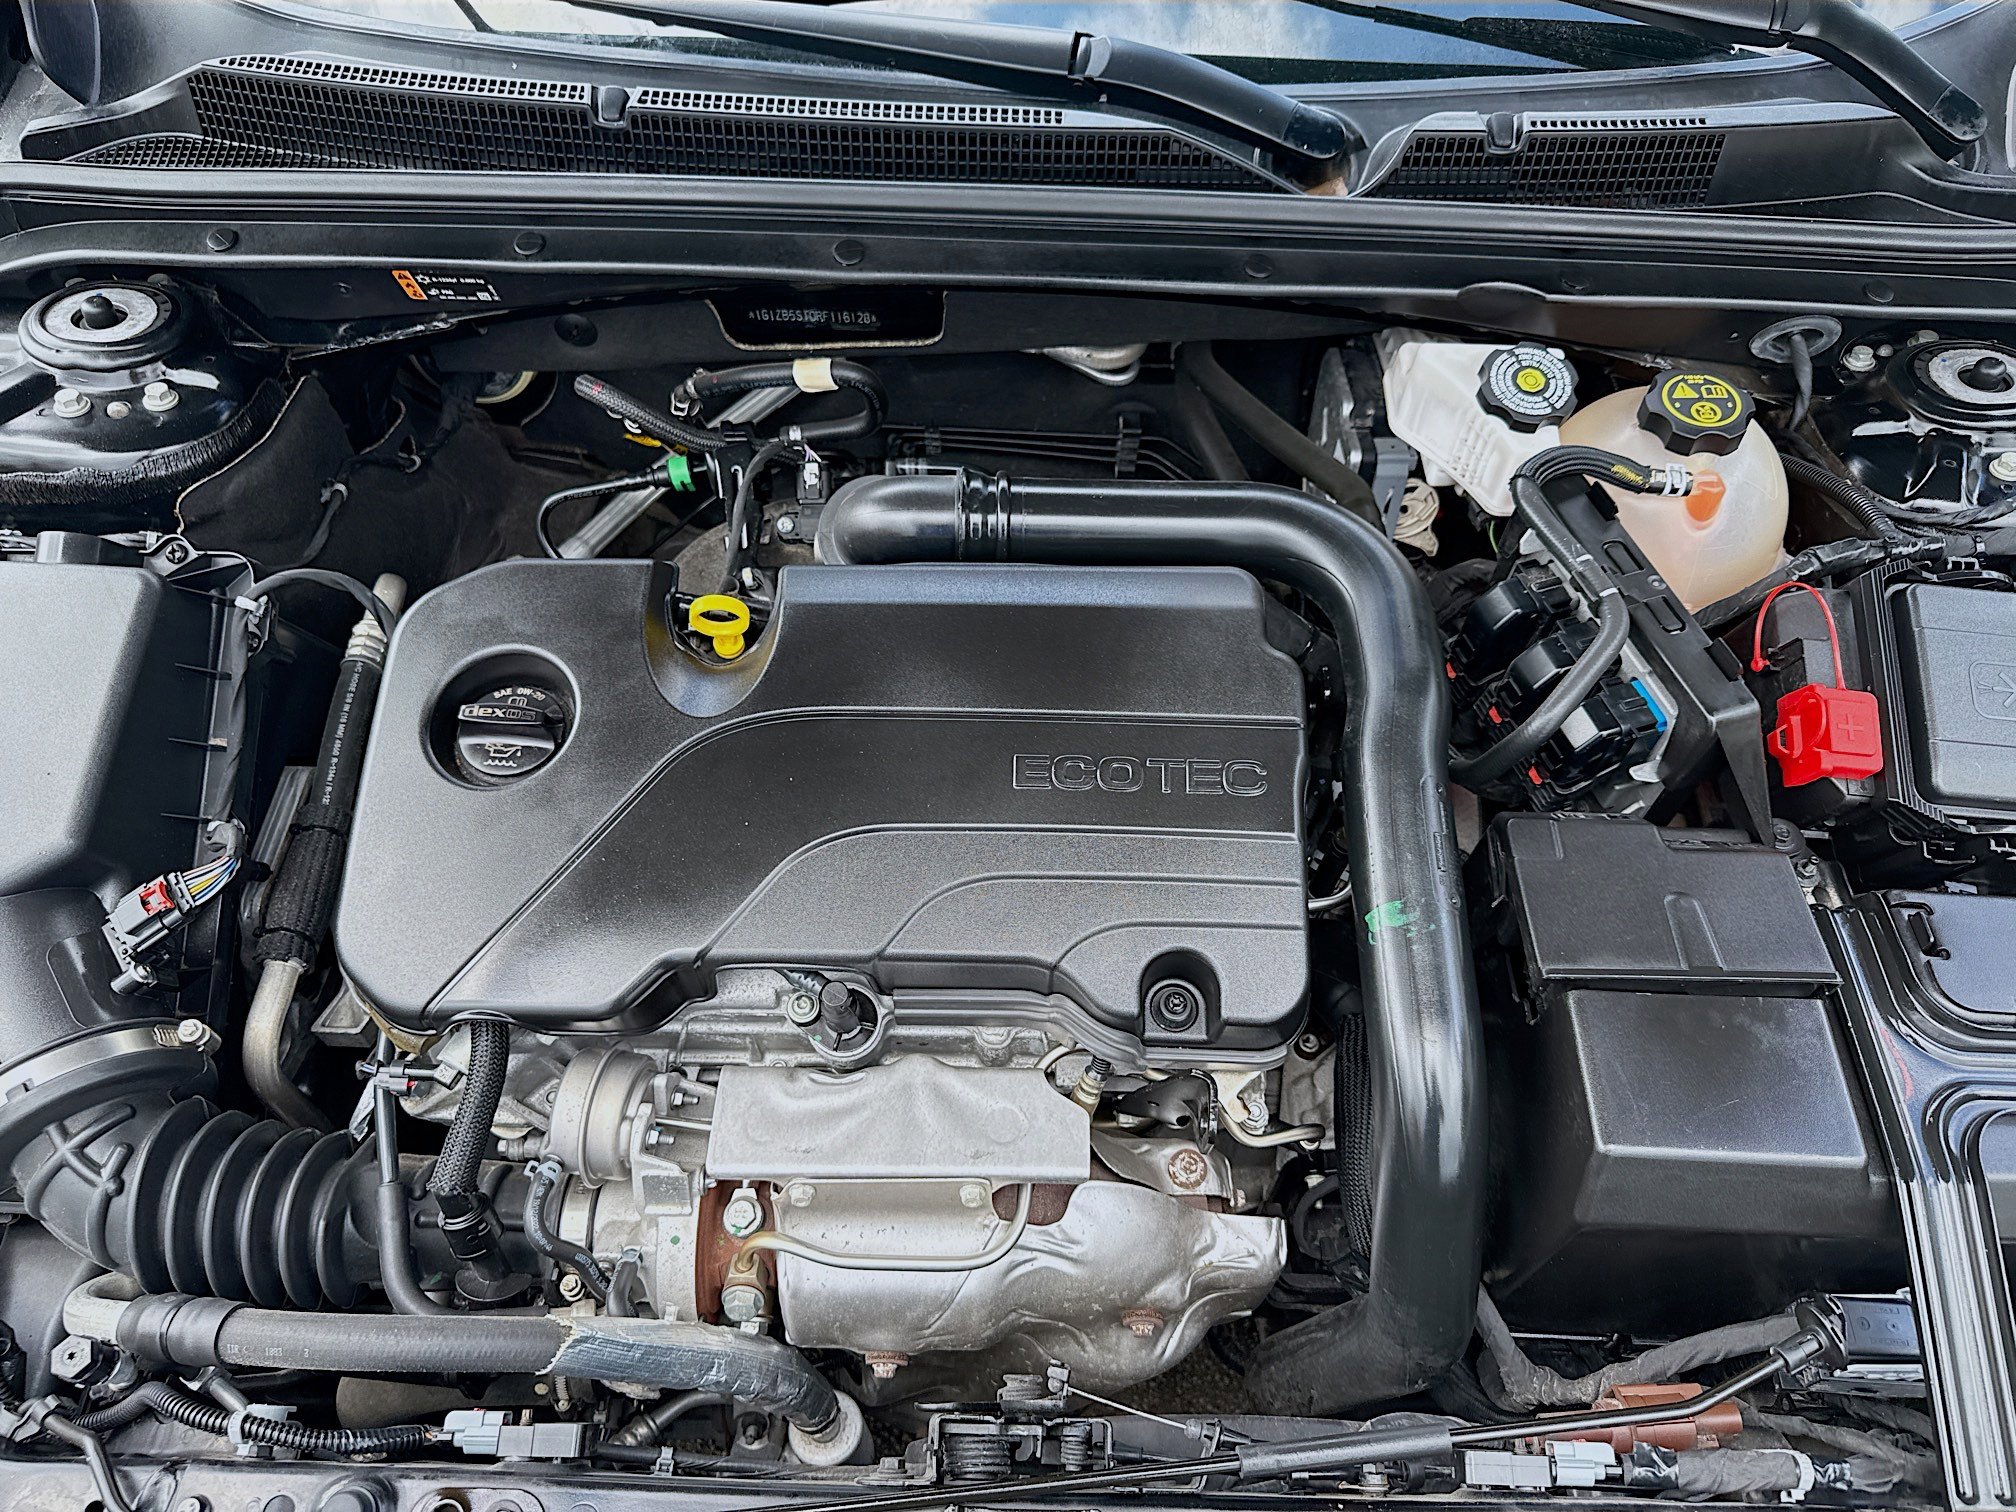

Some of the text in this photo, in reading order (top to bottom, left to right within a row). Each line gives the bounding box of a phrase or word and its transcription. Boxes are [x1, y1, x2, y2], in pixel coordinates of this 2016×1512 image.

[349, 673, 360, 692] HOSE
[493, 688, 546, 701] SAE 0W-20
[463, 705, 537, 722] dexos
[1012, 753, 1268, 797] ECOTEC
